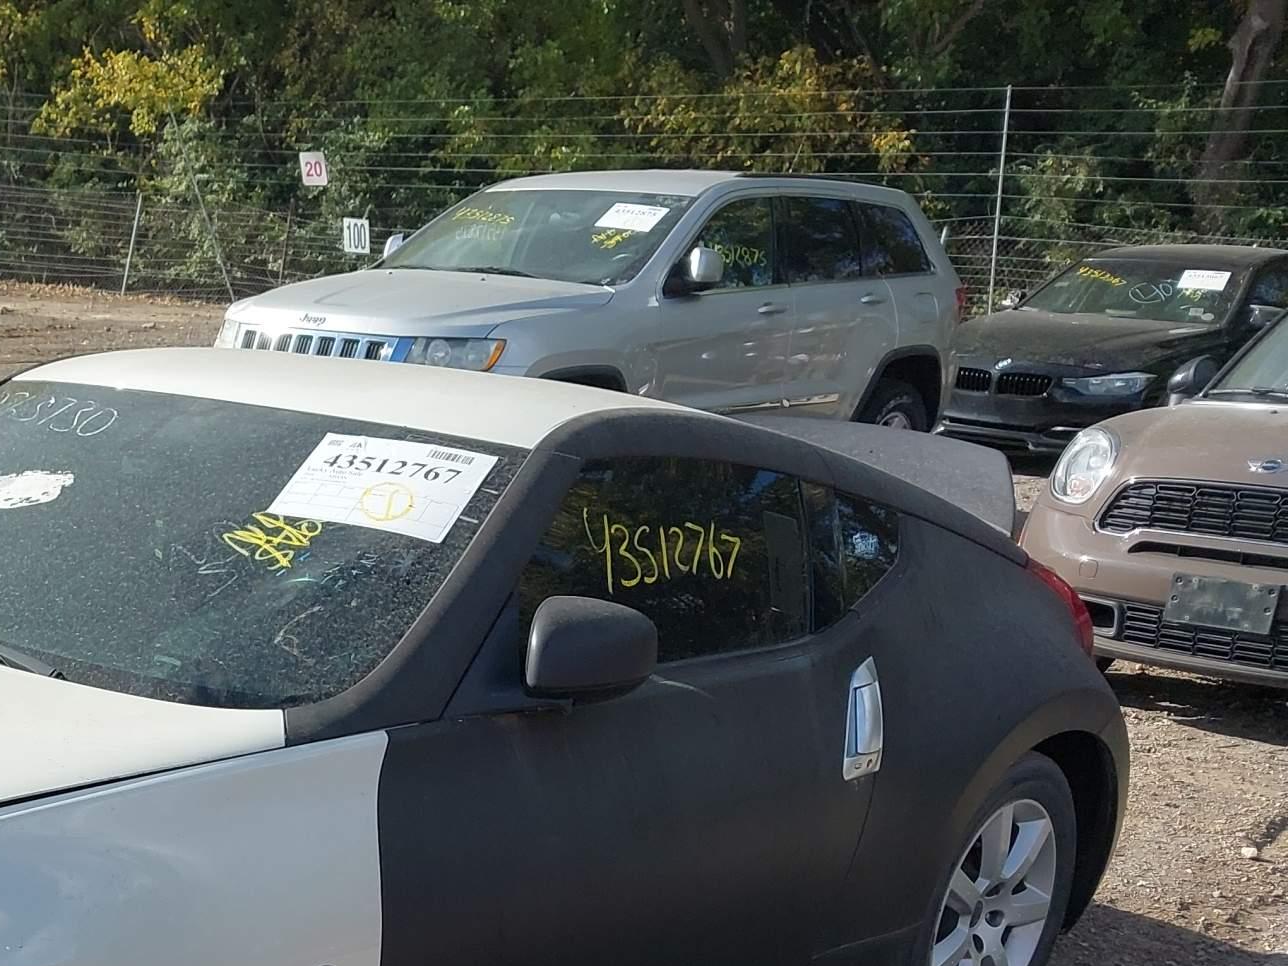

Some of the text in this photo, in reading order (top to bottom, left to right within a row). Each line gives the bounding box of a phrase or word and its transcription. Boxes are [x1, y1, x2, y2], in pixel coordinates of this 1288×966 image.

[304, 160, 323, 178] 20
[346, 222, 367, 250] 100
[299, 312, 327, 326] Jeep
[323, 453, 463, 484] 43512767
[582, 507, 741, 594] 43512767
